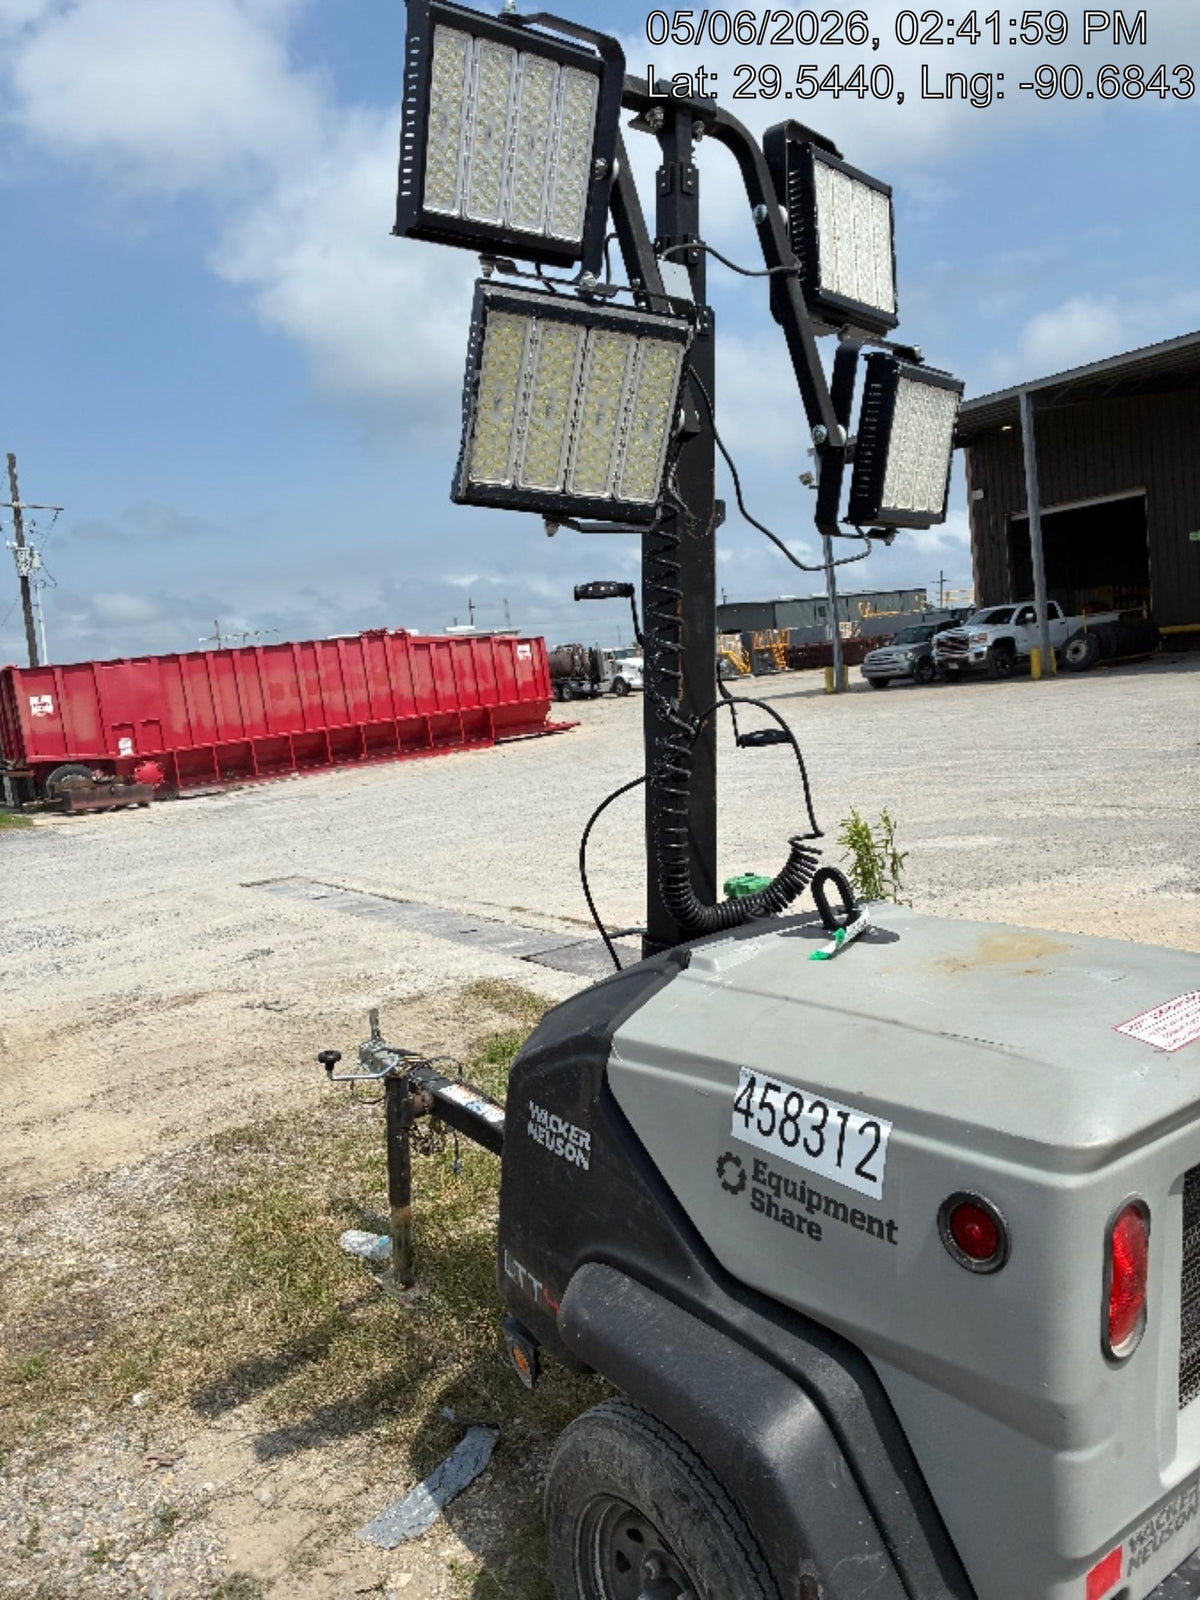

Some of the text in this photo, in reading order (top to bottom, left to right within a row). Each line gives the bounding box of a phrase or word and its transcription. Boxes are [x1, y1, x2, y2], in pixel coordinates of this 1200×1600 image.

[527, 1120, 590, 1171] NEUSON
[529, 1100, 591, 1151] WACKER
[733, 1076, 881, 1183] 458312
[750, 1187, 823, 1242] Share
[751, 1157, 899, 1246] Equipment
[1126, 1503, 1197, 1578] NEUSON
